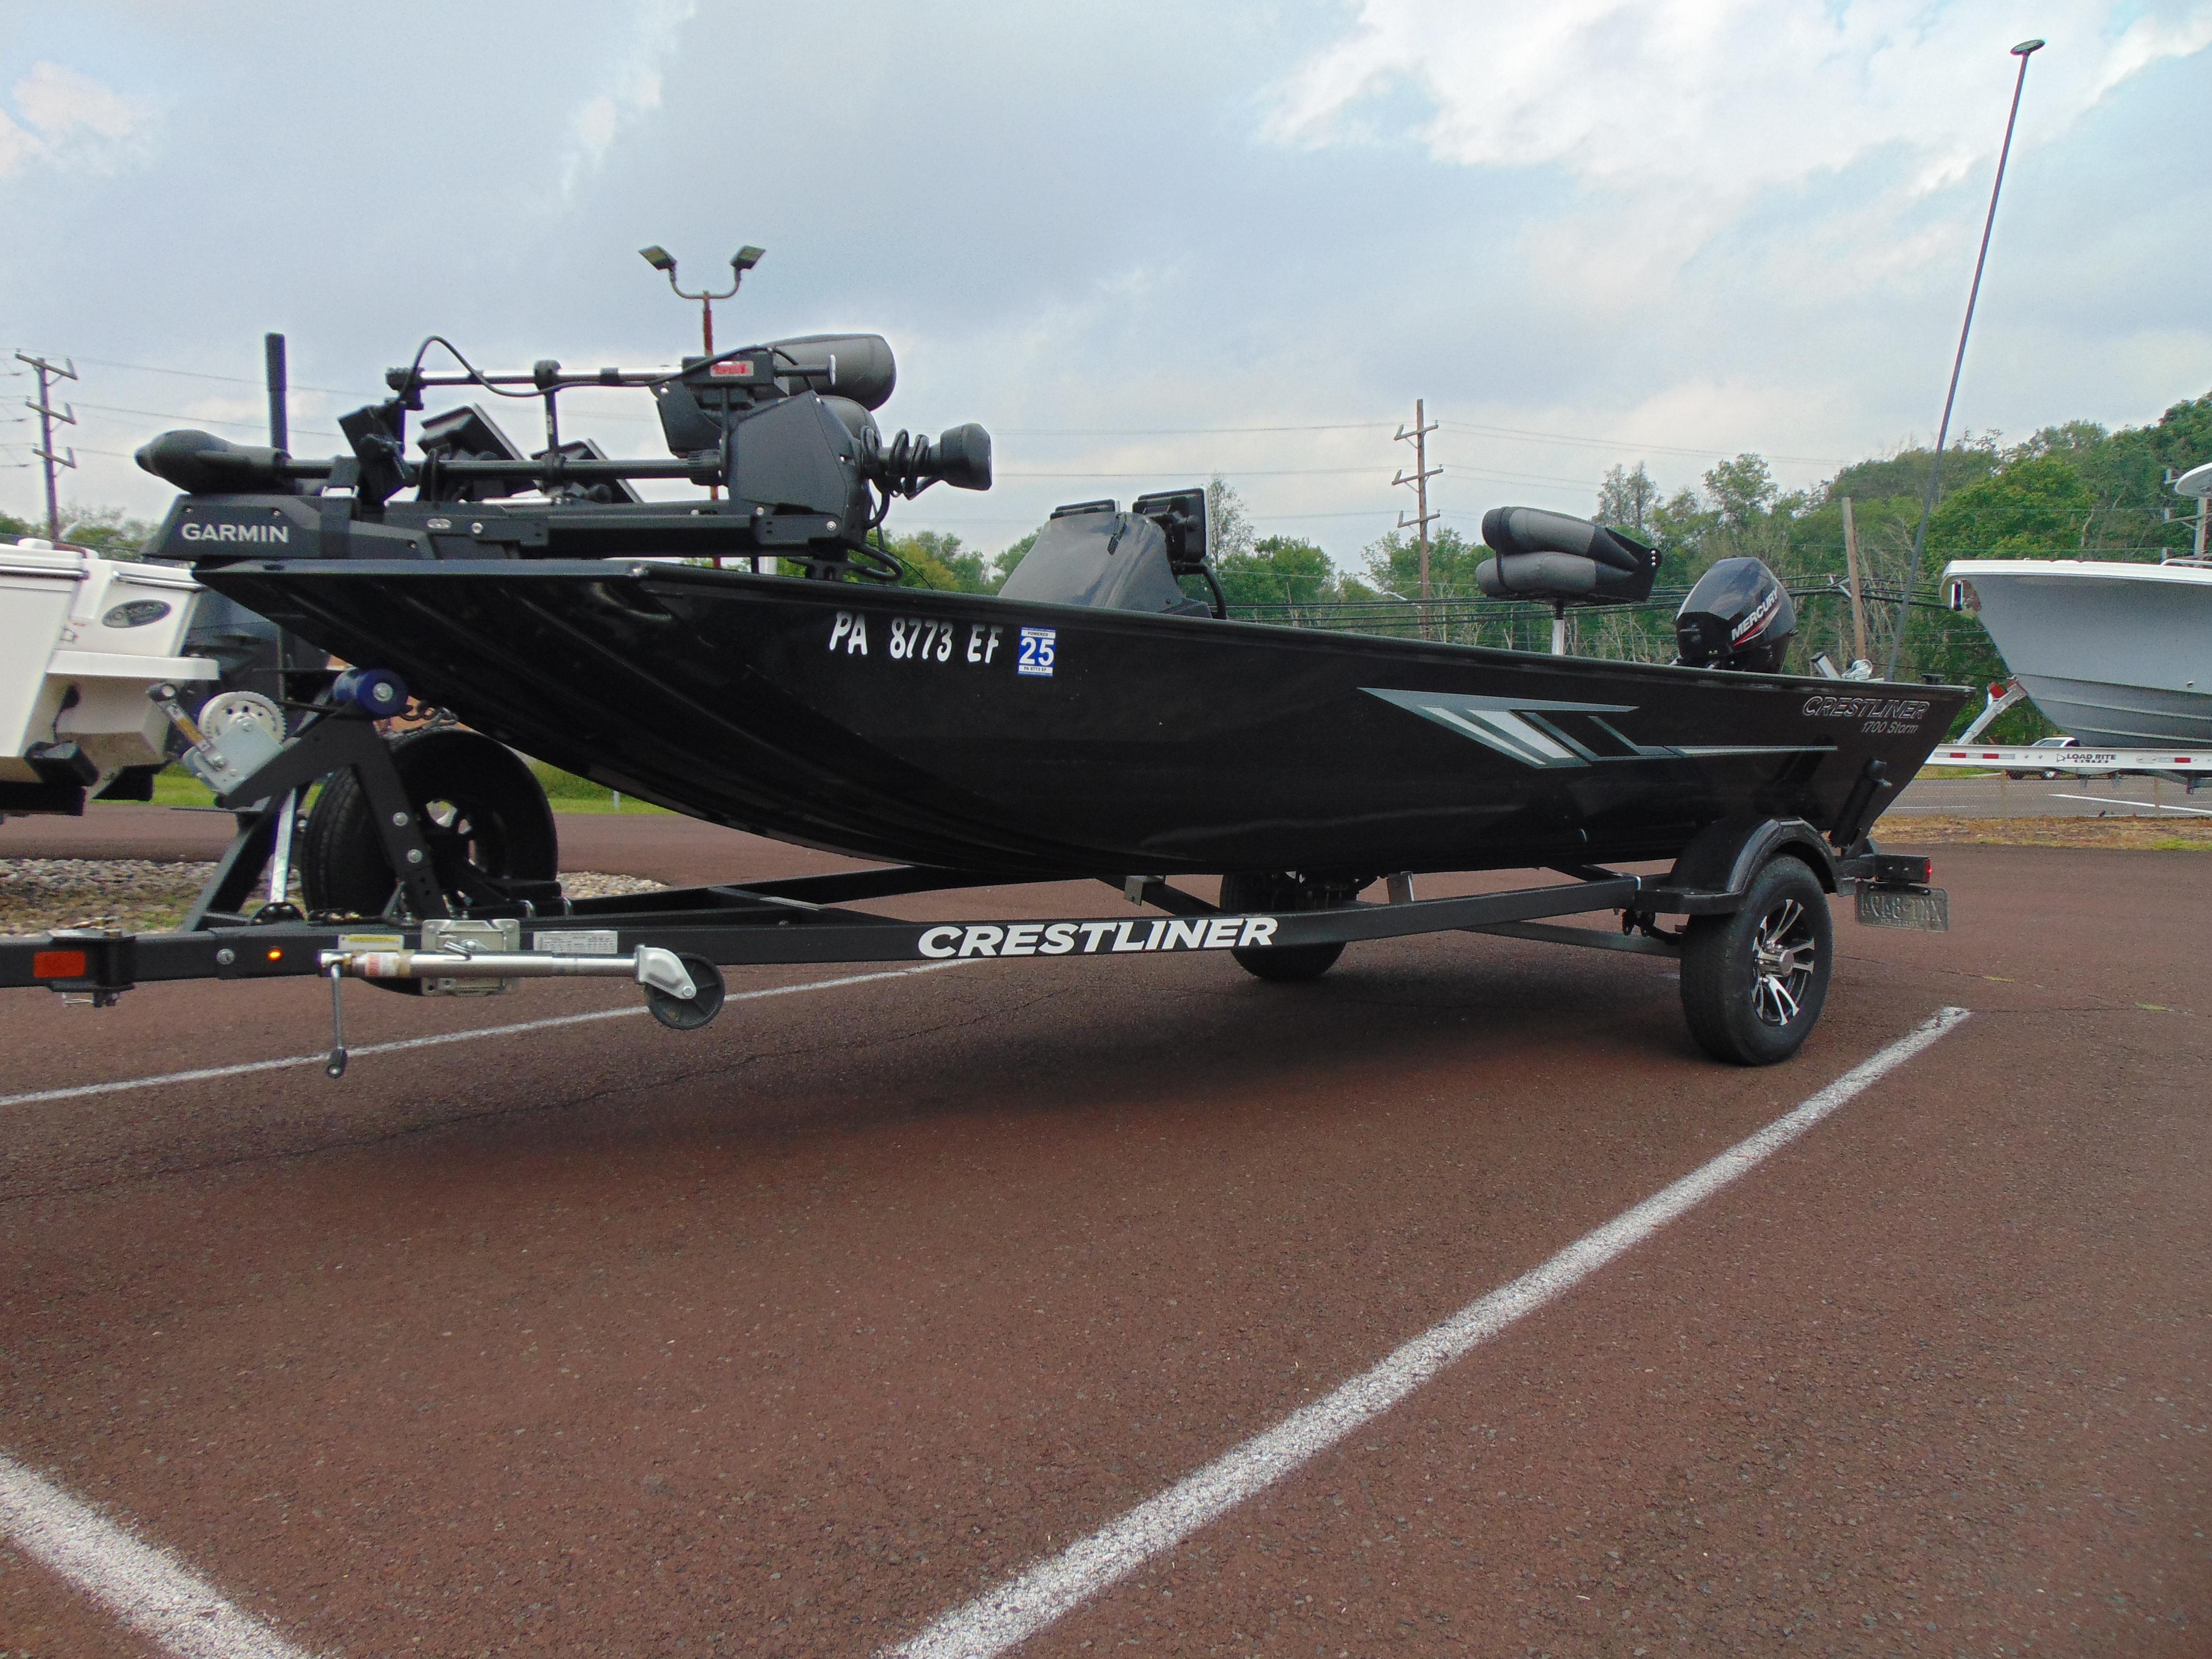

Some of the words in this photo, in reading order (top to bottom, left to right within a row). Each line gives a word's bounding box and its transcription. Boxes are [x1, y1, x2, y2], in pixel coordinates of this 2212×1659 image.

[182, 523, 289, 543] GARMIN
[1732, 586, 1778, 641] MERCURY
[829, 611, 868, 655] PA
[890, 617, 953, 662] 8773
[967, 624, 1003, 664] EF
[1019, 637, 1054, 666] 25
[1803, 696, 1930, 720] CRESTLINER
[1861, 721, 1887, 733] 1700
[1888, 721, 1919, 734] Storm
[918, 917, 1278, 958] CRESTLINER
